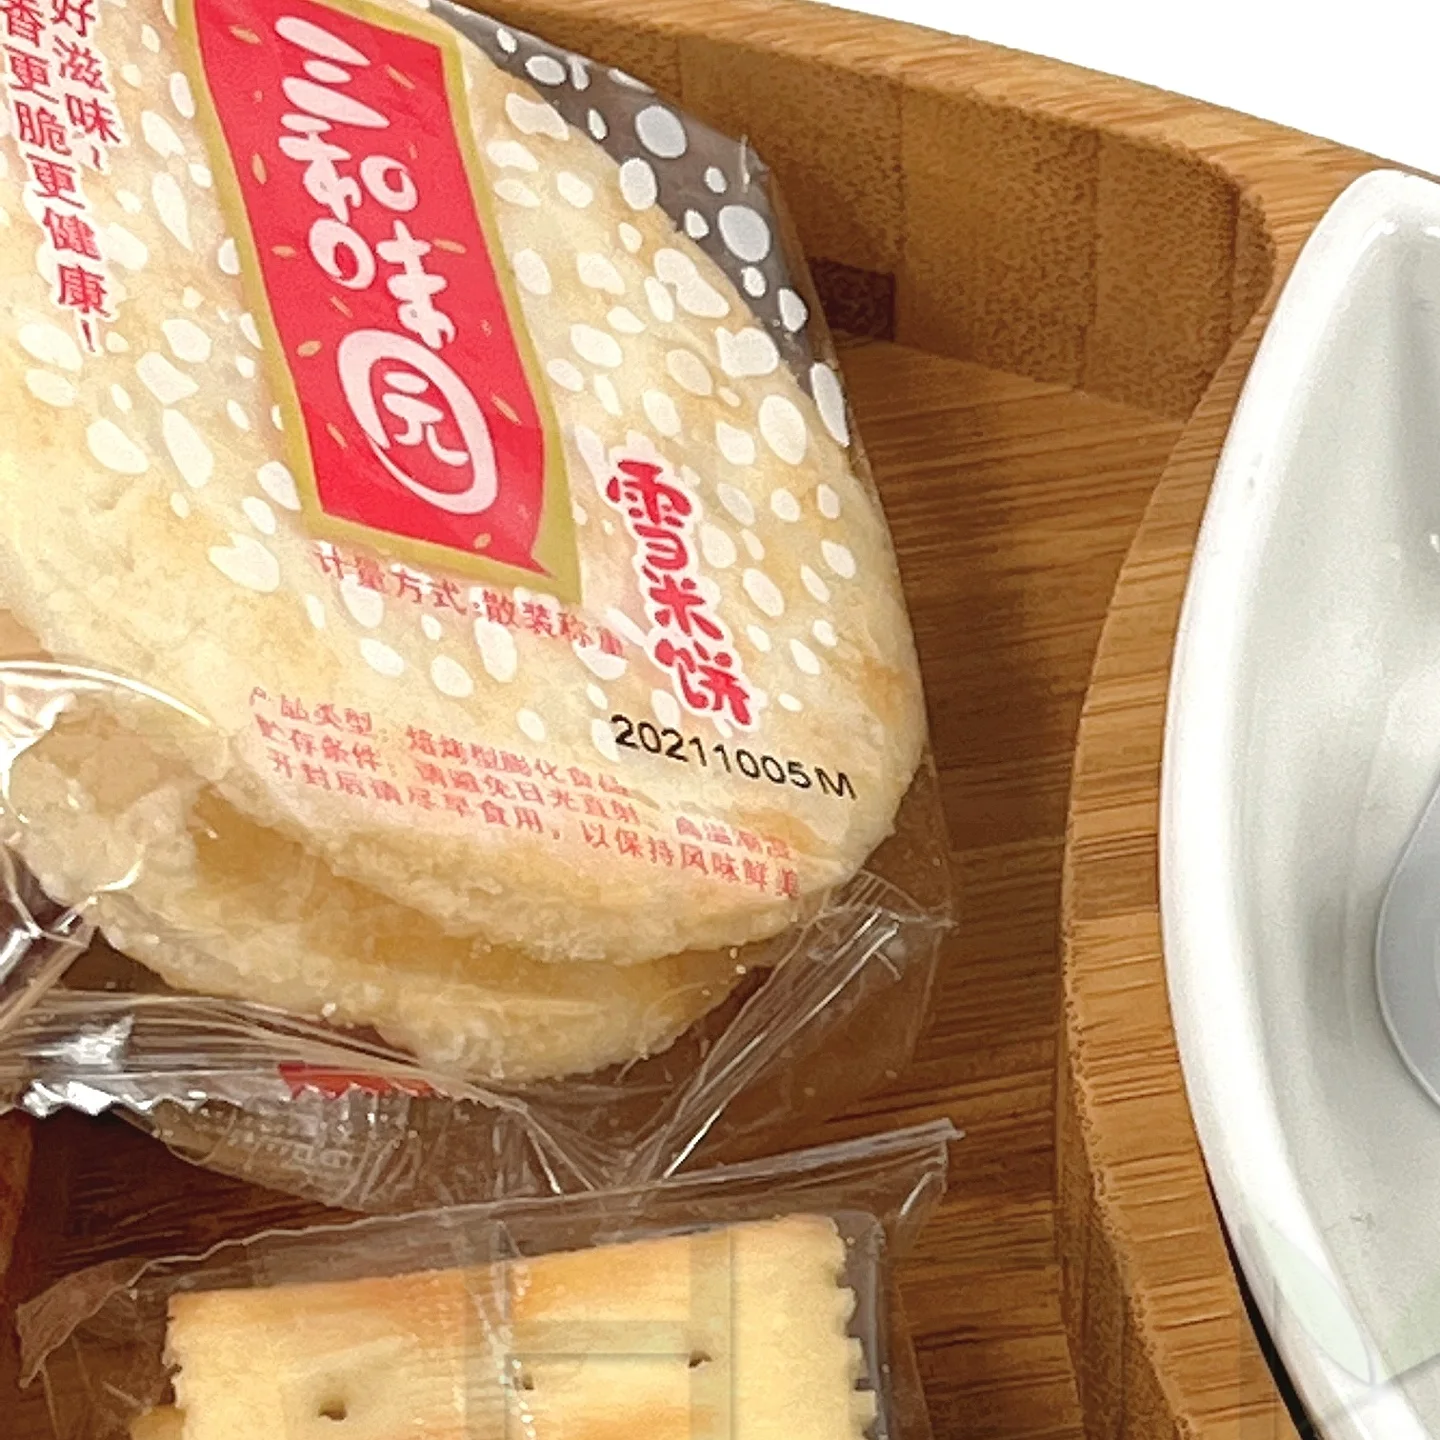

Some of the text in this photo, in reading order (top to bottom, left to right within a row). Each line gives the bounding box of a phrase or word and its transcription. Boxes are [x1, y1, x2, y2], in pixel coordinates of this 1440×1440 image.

[606, 459, 753, 726] 雪米饼
[611, 713, 858, 800] 20211005M
